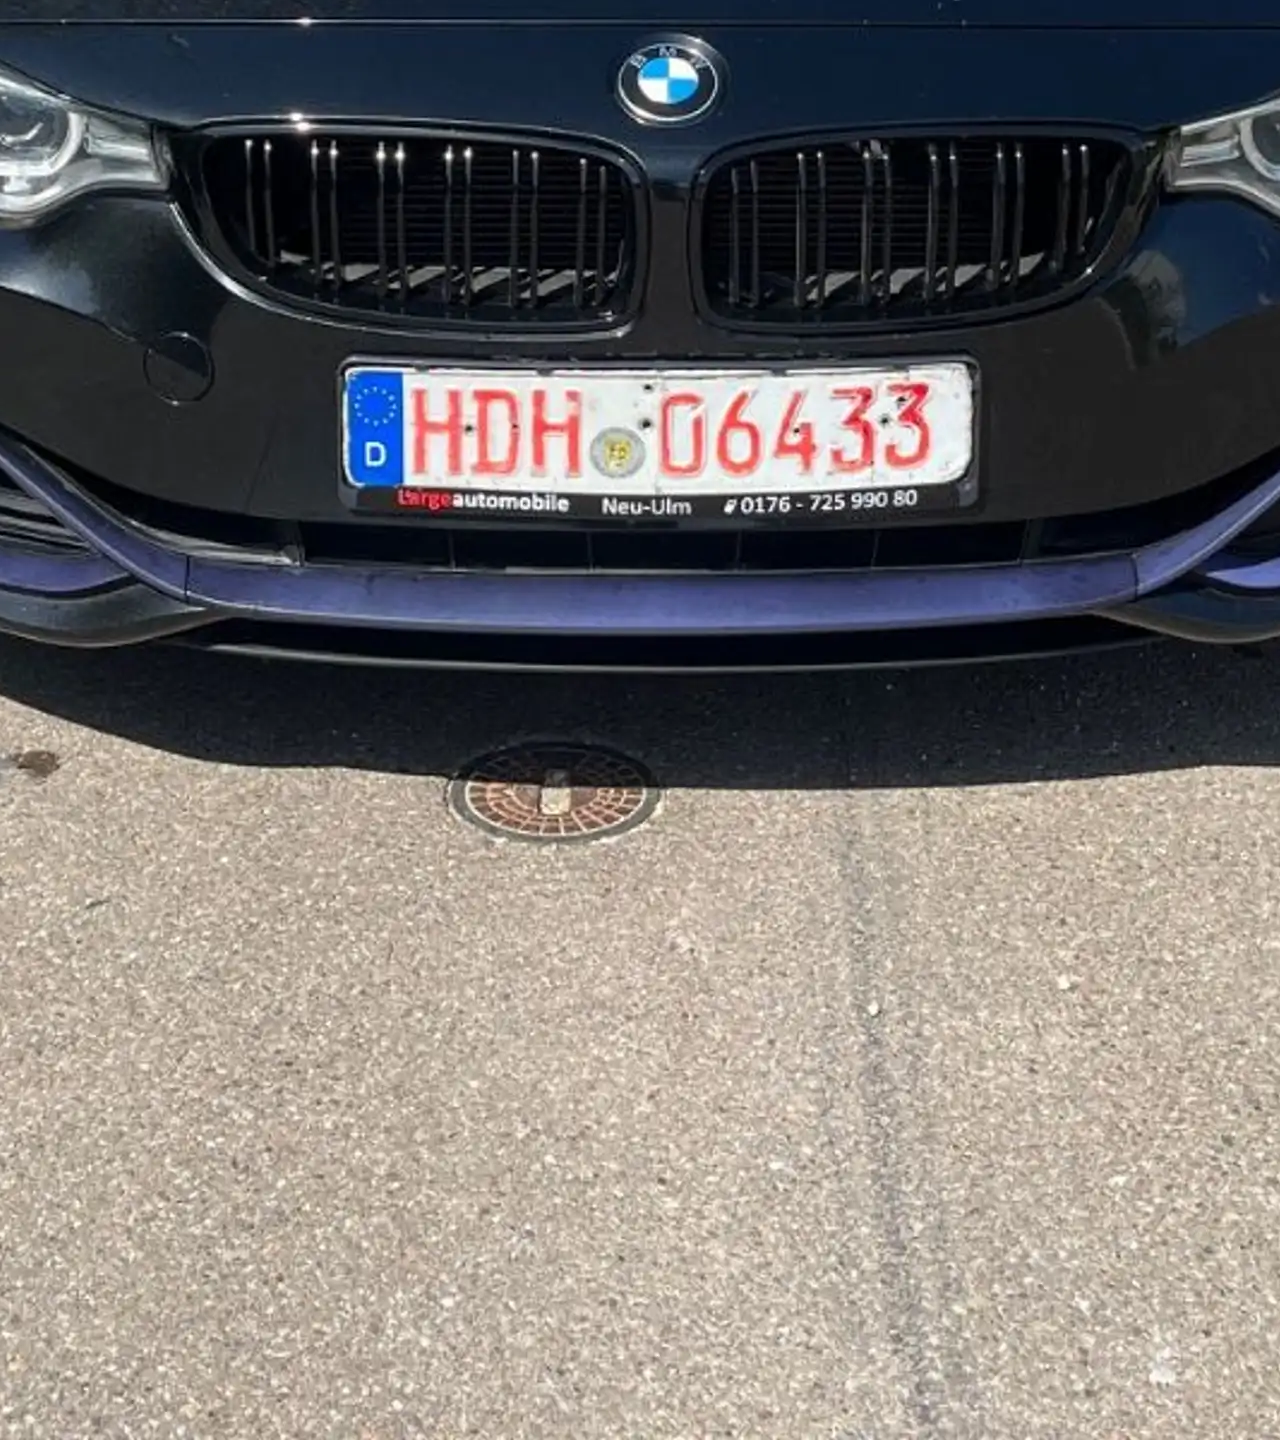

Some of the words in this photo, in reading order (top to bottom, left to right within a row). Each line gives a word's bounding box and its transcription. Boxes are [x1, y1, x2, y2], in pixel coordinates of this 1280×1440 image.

[412, 389, 582, 477] HDH
[659, 383, 931, 478] 06433
[364, 441, 387, 467] D
[601, 497, 693, 515] Neu-Ulm
[740, 496, 791, 514] 0176
[810, 493, 846, 511] 725
[851, 491, 888, 509] 990
[892, 489, 918, 507] 80
